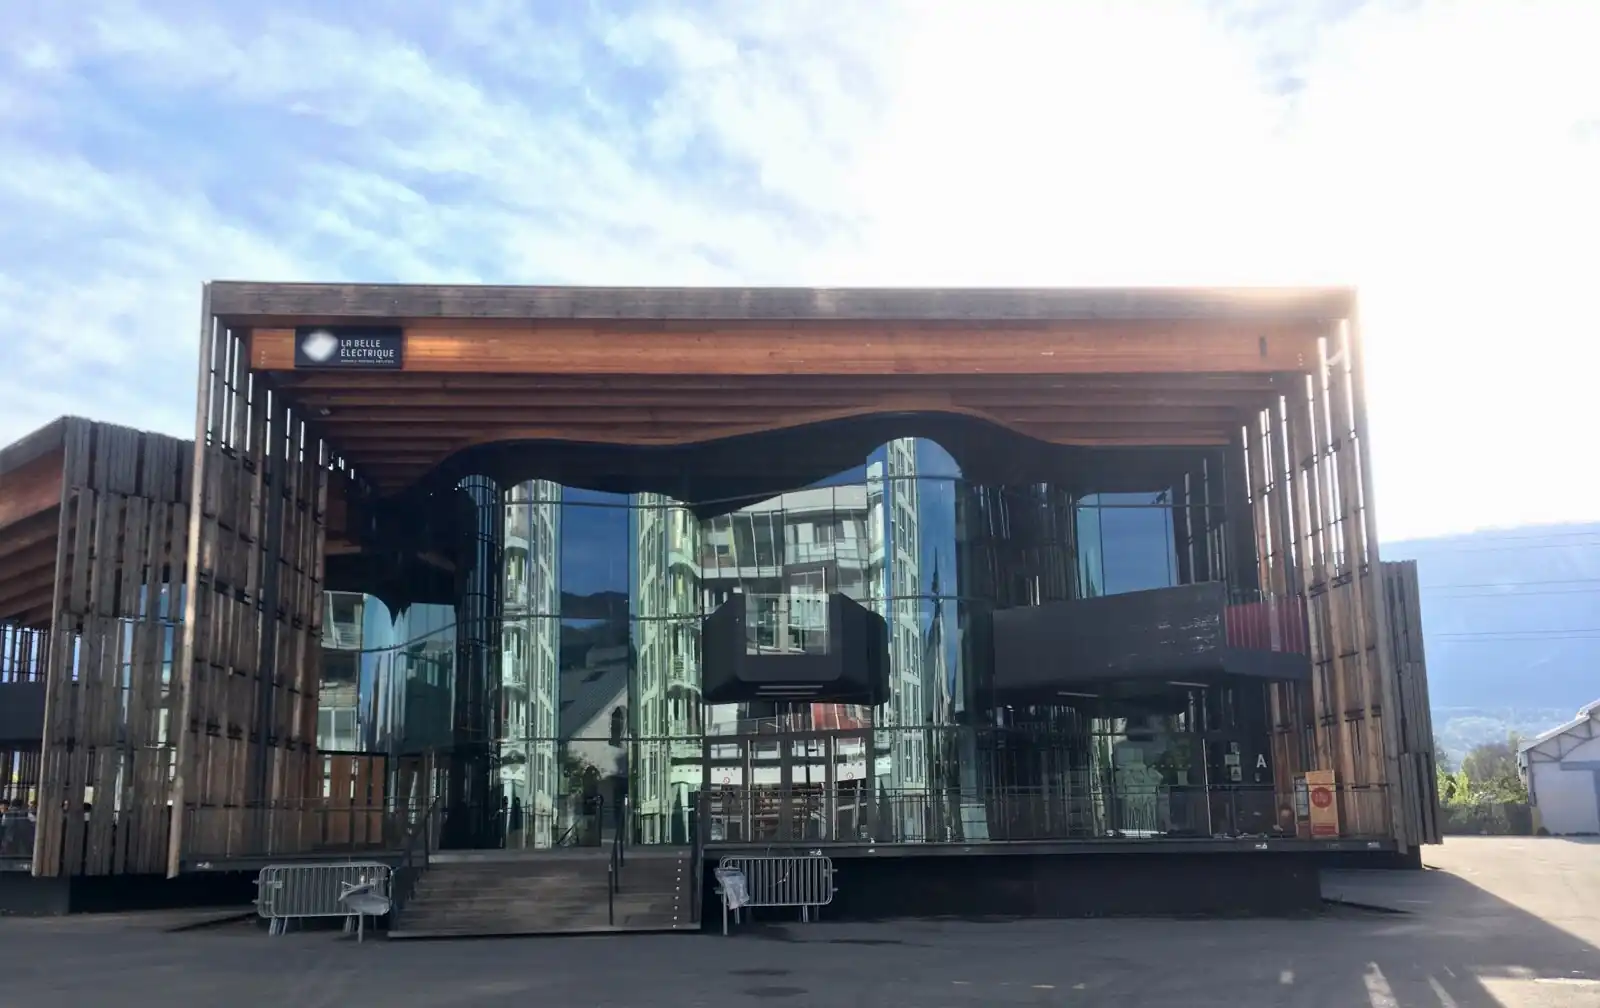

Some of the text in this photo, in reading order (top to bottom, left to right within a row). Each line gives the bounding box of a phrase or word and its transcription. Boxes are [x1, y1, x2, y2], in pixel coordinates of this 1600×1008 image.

[341, 339, 381, 348] LA BELLE
[1256, 753, 1267, 768] A
